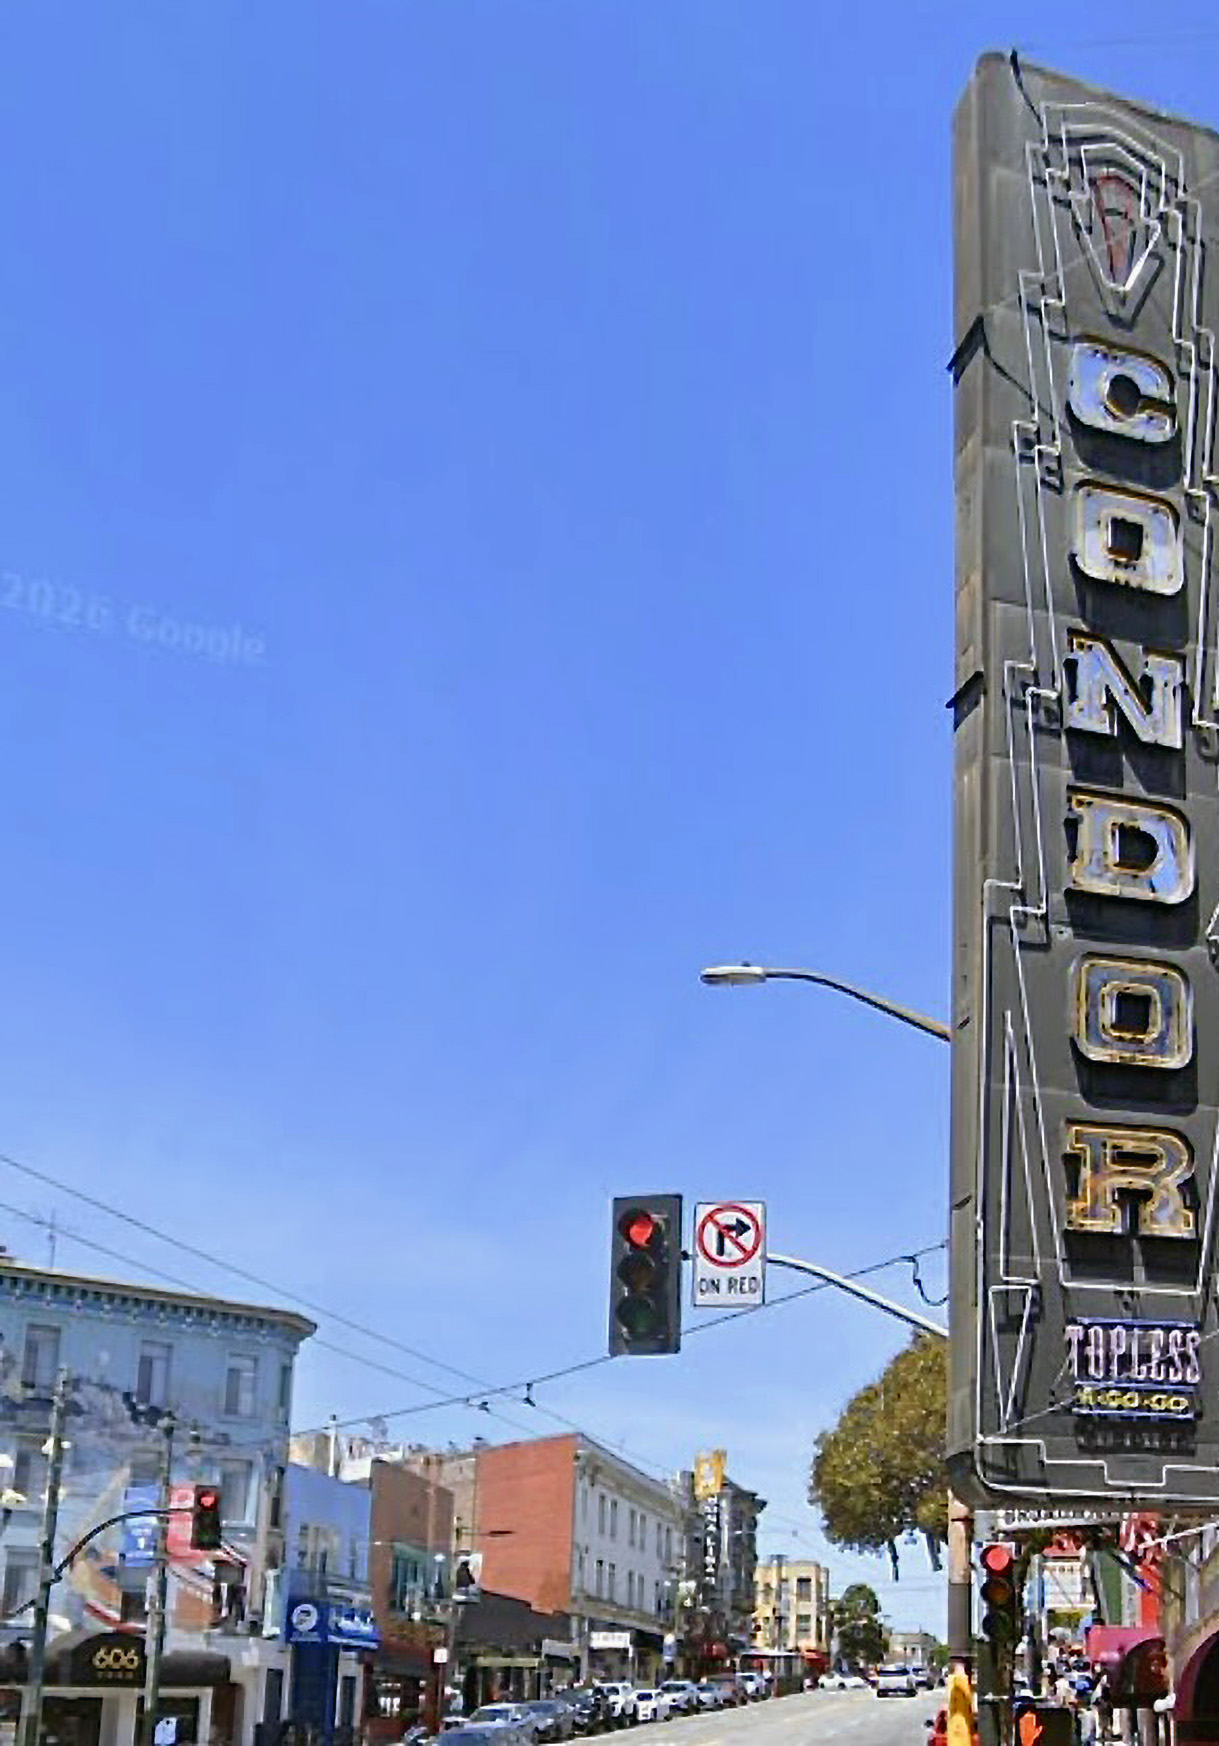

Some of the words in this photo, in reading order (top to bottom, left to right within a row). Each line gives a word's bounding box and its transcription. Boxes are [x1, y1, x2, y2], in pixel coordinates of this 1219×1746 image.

[1065, 334, 1197, 1240] CONDOR
[699, 1277, 720, 1296] ON
[727, 1276, 759, 1295] RED
[1065, 1325, 1201, 1384] TOPLESS
[92, 1648, 139, 1669] 606
